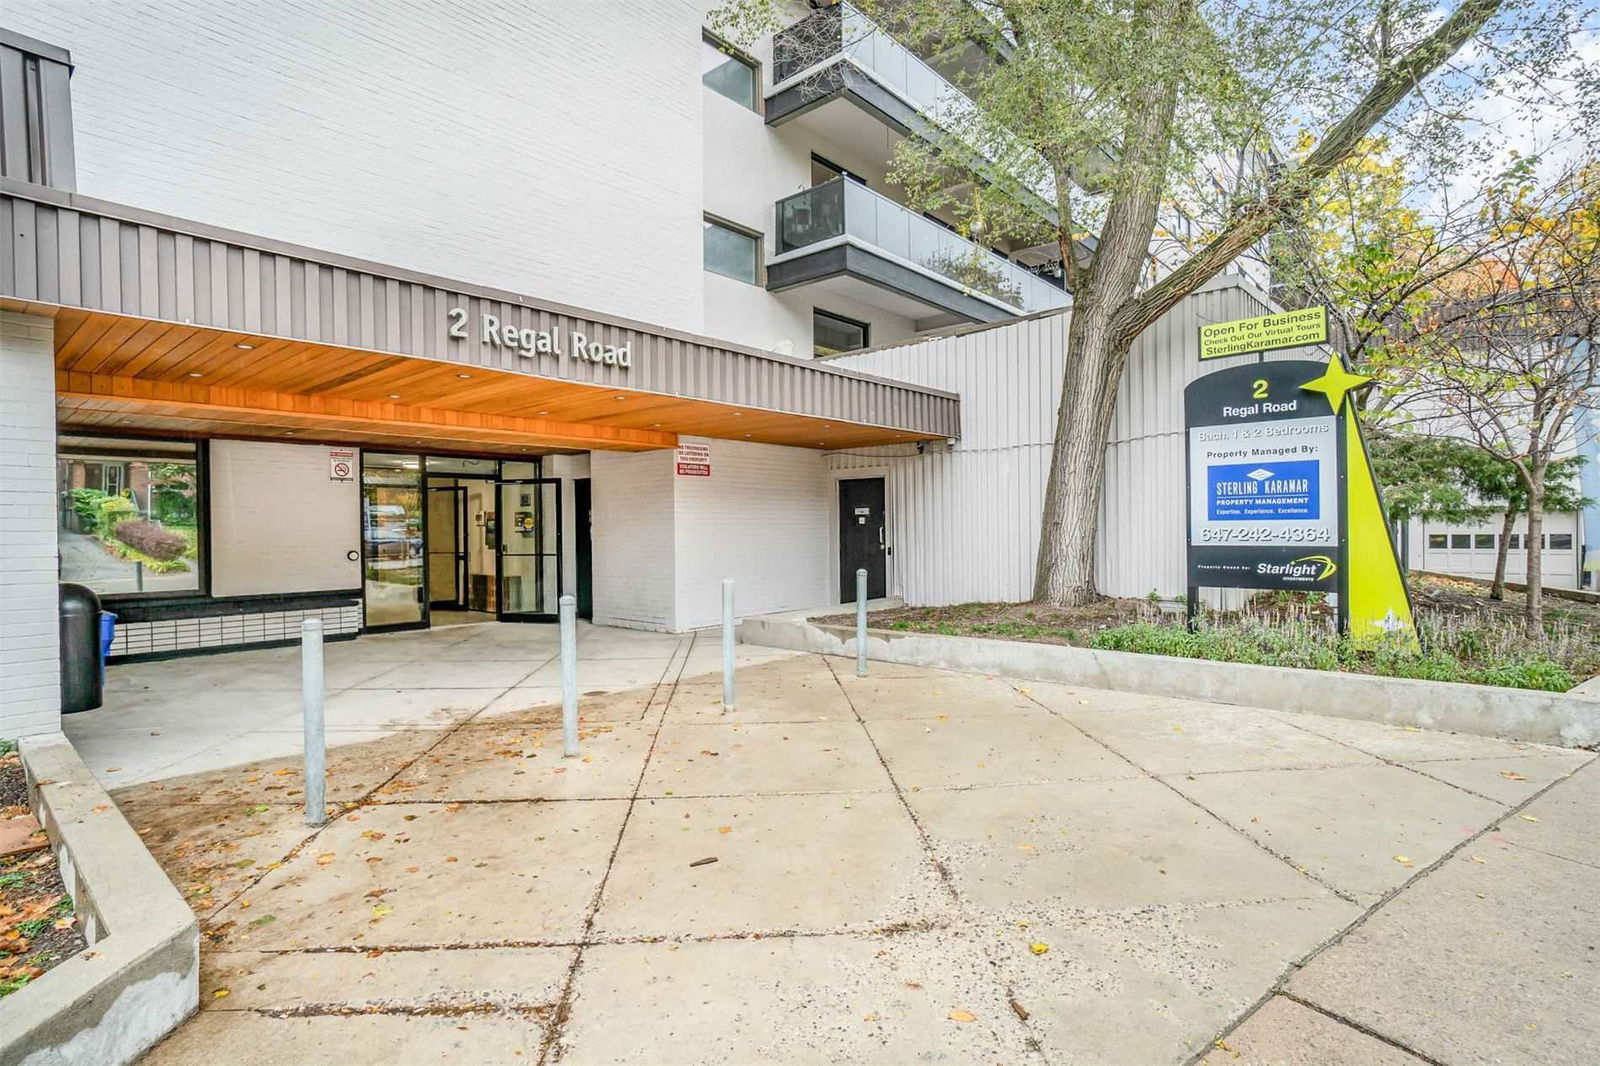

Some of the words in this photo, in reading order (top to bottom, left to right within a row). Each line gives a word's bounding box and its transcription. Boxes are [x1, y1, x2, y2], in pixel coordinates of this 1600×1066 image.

[1204, 326, 1234, 338] Open
[1239, 322, 1259, 332] For
[1264, 311, 1320, 328] Business
[449, 307, 468, 338] 2
[482, 313, 561, 358] Regal
[572, 331, 632, 368] Road
[1204, 336, 1228, 346] Check
[1265, 326, 1293, 336] Virtual
[1296, 322, 1320, 330] Tours
[1206, 332, 1320, 356] SterlingKaramar.com
[1252, 380, 1269, 398] 2
[1223, 405, 1258, 417] Regal
[1263, 400, 1297, 413] Road
[1199, 431, 1230, 442] Bach.
[1233, 430, 1238, 438] 1
[1242, 429, 1250, 438] &
[1254, 428, 1262, 438] 2
[1265, 423, 1329, 436] Bedrooms
[1207, 450, 1247, 459] Property
[1252, 446, 1297, 457] Managed
[1302, 445, 1318, 454] By:
[1216, 480, 1258, 496] STERLING
[1264, 479, 1308, 494] KARAMAR
[1200, 527, 1330, 542] 647-242-4364
[1257, 563, 1316, 576] Starlight
